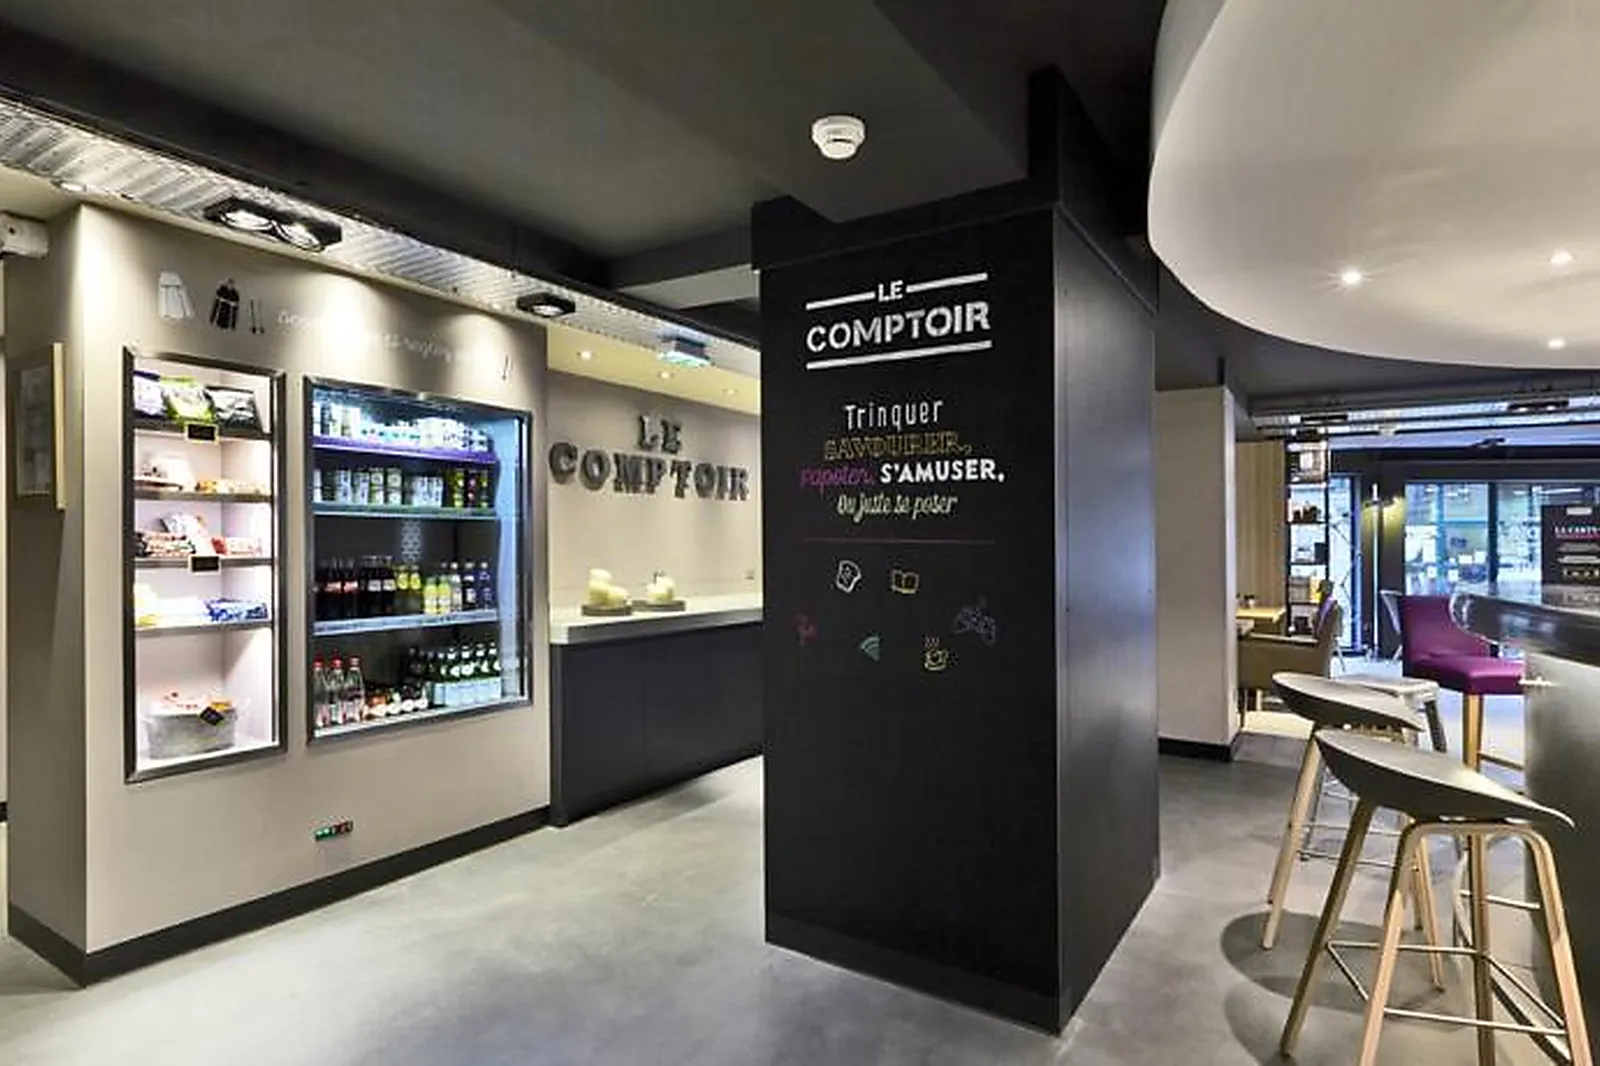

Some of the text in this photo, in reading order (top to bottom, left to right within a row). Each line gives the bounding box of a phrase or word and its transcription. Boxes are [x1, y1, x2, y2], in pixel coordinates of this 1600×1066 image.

[877, 280, 904, 303] LE
[806, 301, 991, 352] COMPTOIR
[845, 400, 943, 431] Trinquer
[639, 415, 682, 454] LE
[549, 442, 750, 502] COMPTOIR
[910, 494, 959, 520] poser
